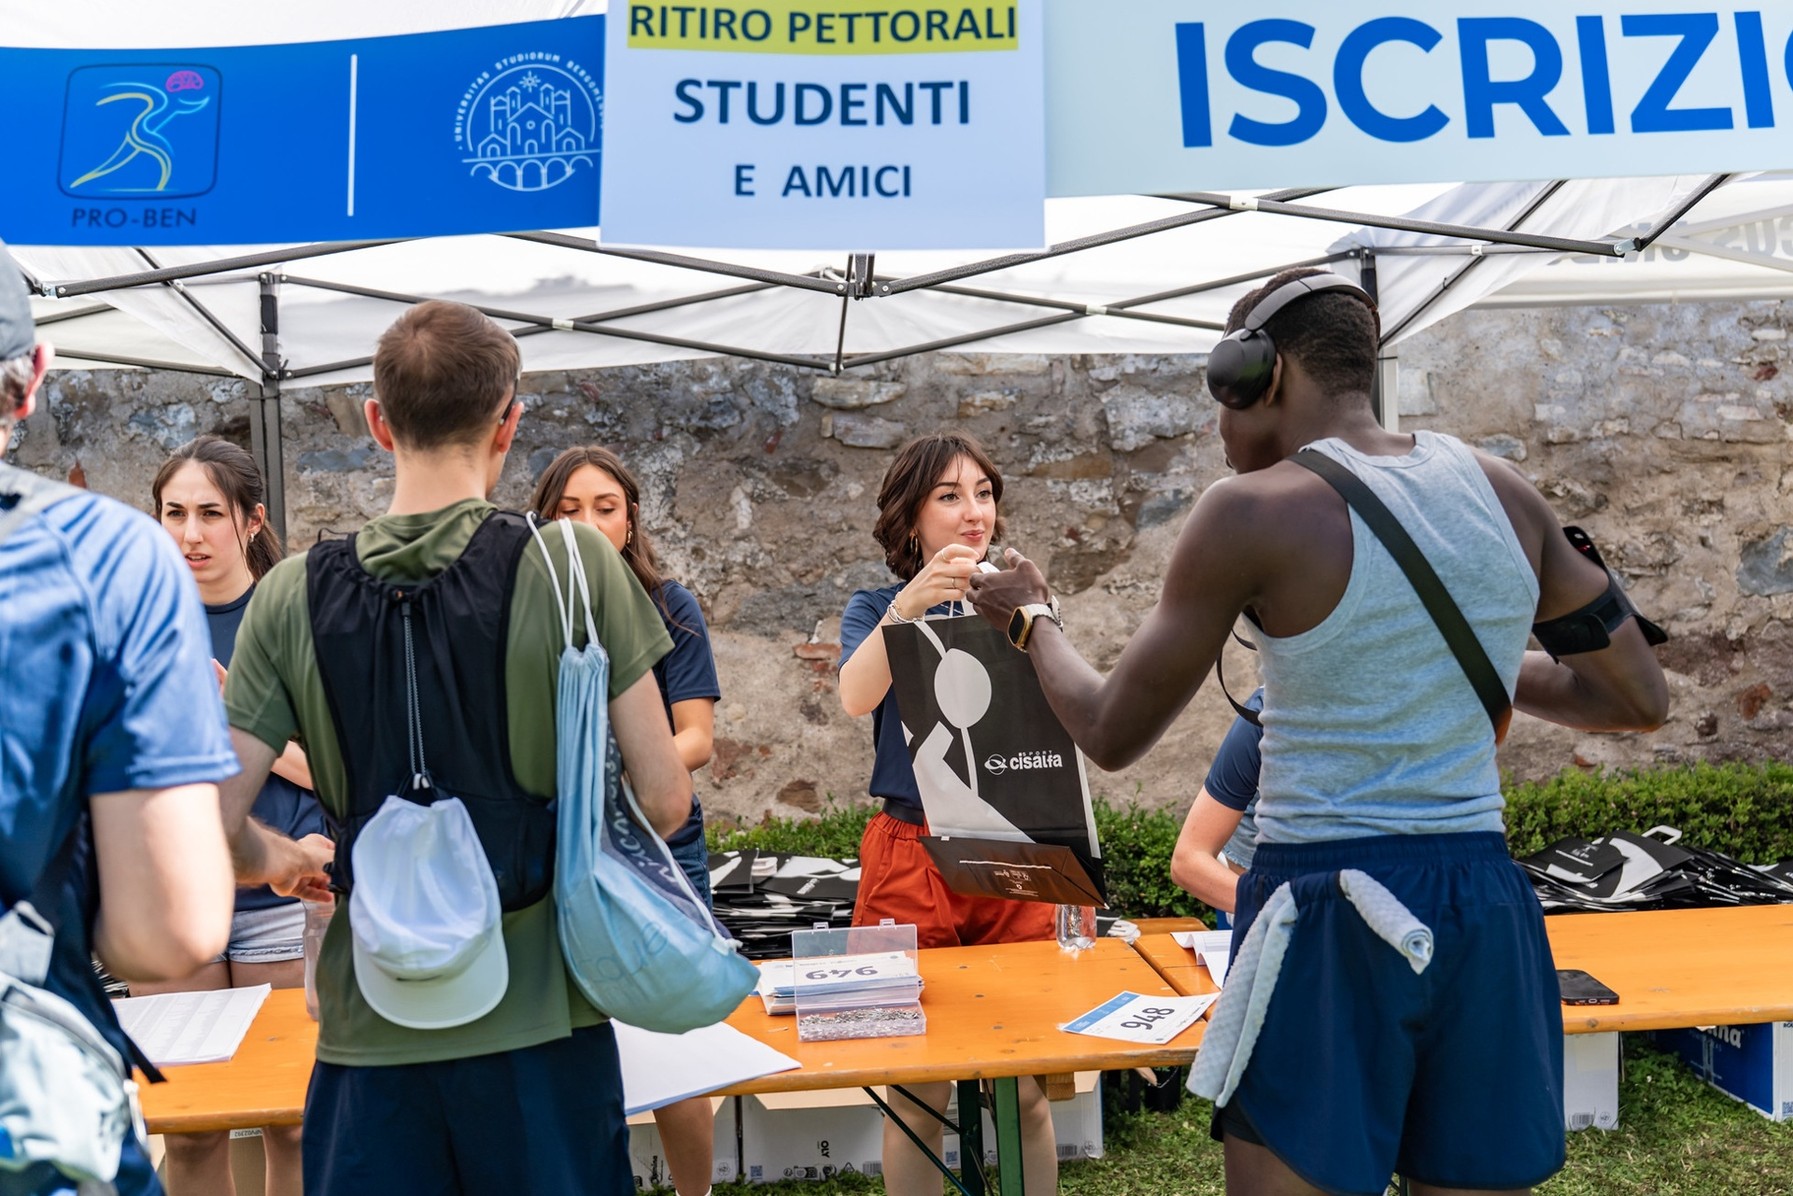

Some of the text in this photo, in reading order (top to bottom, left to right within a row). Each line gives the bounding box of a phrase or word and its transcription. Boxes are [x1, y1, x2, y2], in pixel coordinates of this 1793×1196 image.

[629, 3, 1018, 45] RITIRO PETTORALI
[1175, 10, 1793, 148] ISCRIZI
[454, 71, 490, 142] UNIVERSITAS
[494, 51, 561, 71] STUDIORUM
[673, 78, 970, 127] STUDENTI
[734, 164, 912, 198] E AMICI
[71, 207, 197, 229] PRO-BEN
[1009, 752, 1063, 770] cisalfa
[805, 965, 878, 980] 949
[1120, 1007, 1176, 1031] 948
